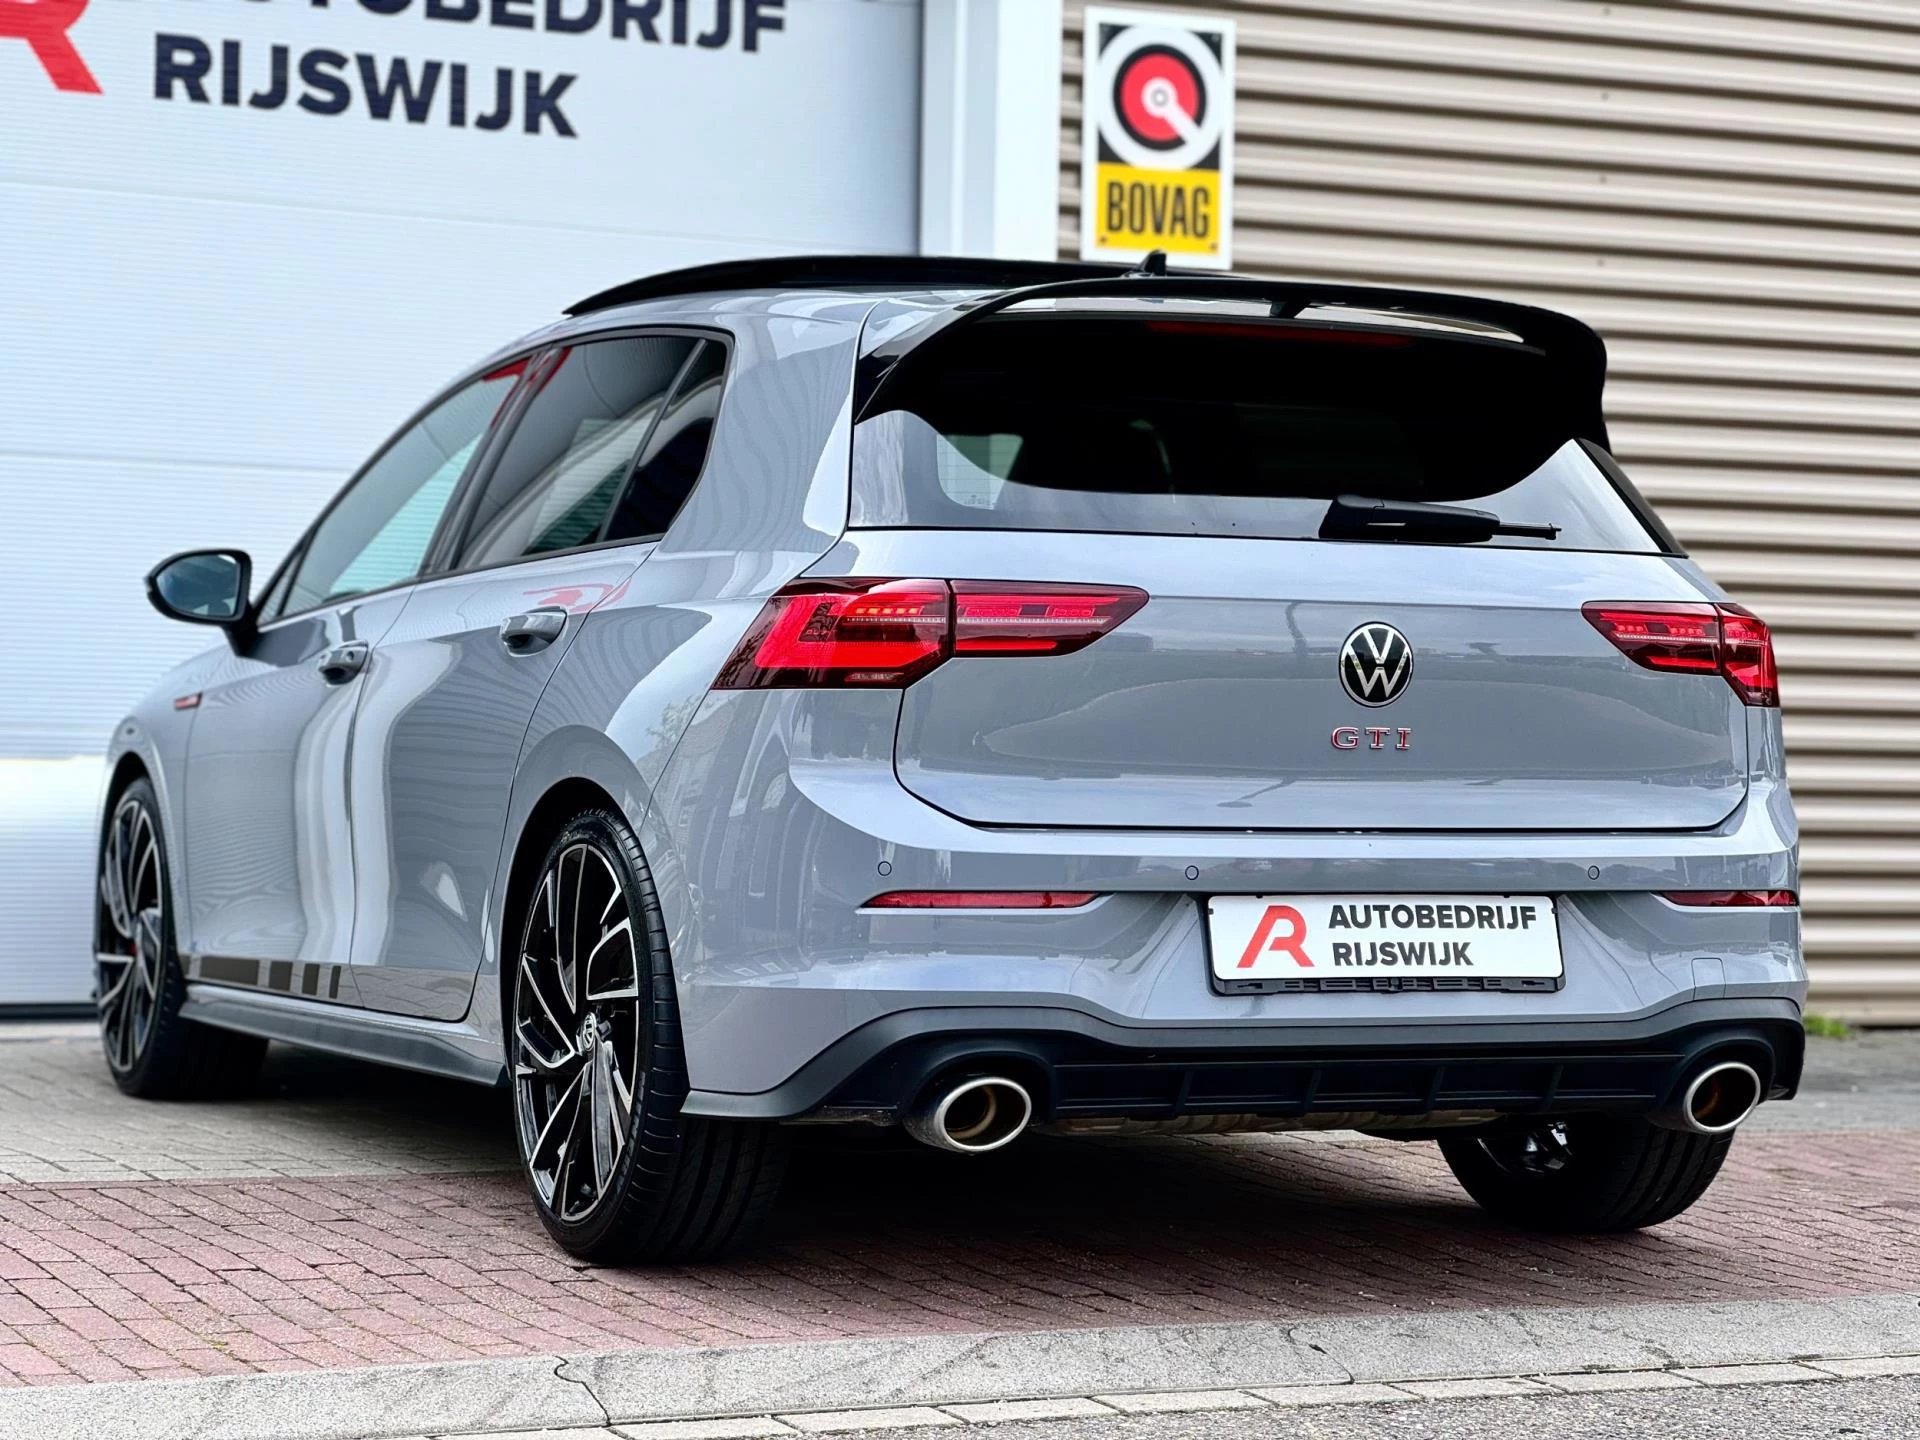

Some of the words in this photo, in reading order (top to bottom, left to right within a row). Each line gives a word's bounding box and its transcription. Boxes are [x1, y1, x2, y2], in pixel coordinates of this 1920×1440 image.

[154, 33, 578, 138] RIJSWIJK
[1107, 181, 1209, 239] BOVAG
[1331, 726, 1412, 750] GTI
[1328, 904, 1537, 930] AUTOBEDRIJF
[1332, 941, 1474, 966] RIJSWIJK
